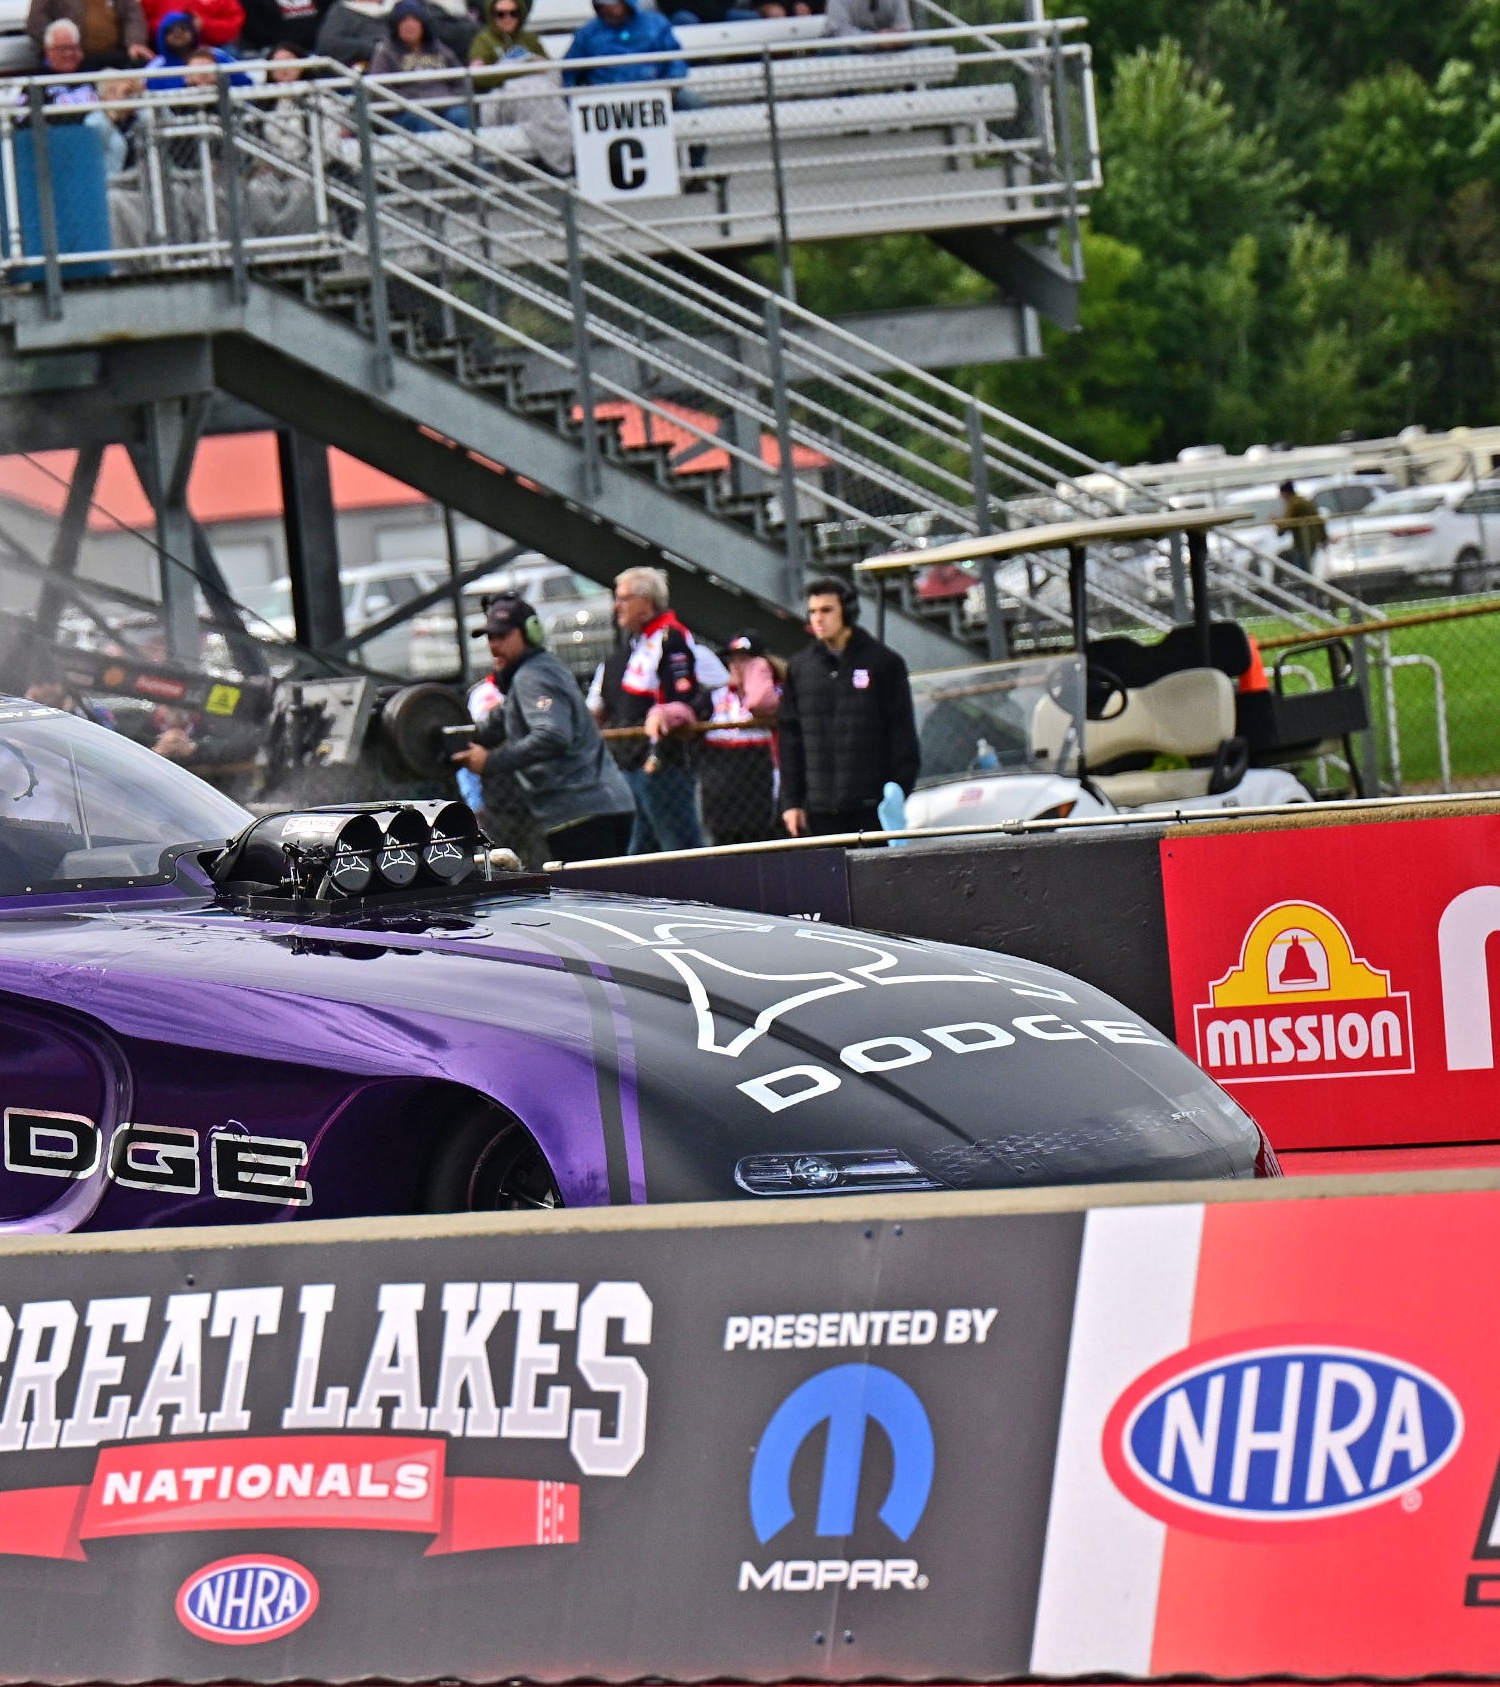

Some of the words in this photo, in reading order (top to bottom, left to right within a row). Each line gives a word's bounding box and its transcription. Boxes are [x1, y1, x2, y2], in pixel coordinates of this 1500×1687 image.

[579, 99, 667, 132] TOWER
[609, 137, 645, 190] C
[1206, 1010, 1403, 1067] MISSION
[735, 1014, 1171, 1114] DODGE
[724, 1310, 938, 1351] PRESENTED
[943, 1307, 999, 1344] BY
[281, 1282, 654, 1477] LAKES
[1157, 1361, 1428, 1505] NHRA
[102, 1463, 430, 1505] NATIONALS
[738, 1559, 919, 1592] MOPAR
[197, 1579, 297, 1627] NHRA
